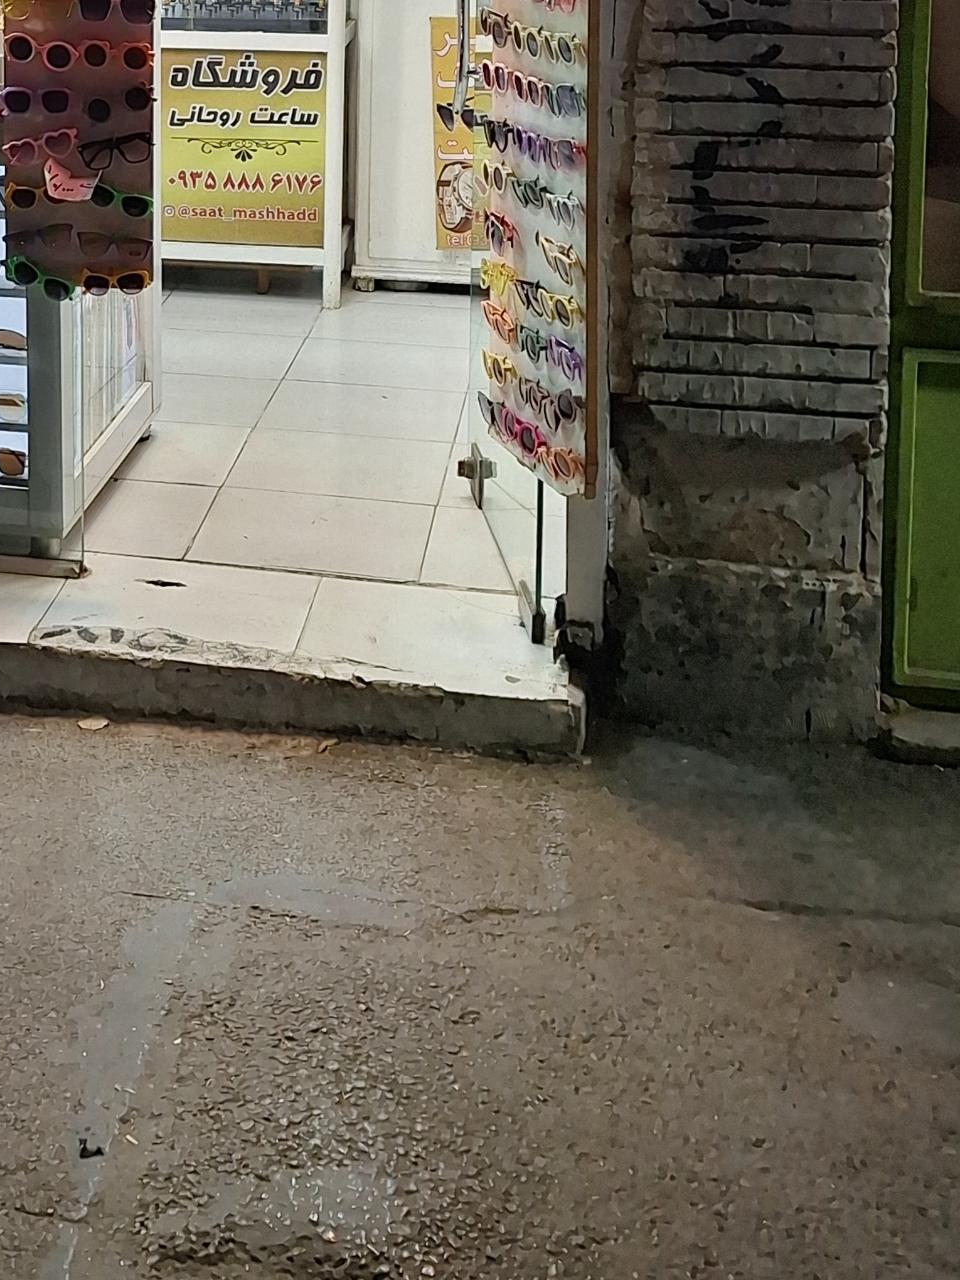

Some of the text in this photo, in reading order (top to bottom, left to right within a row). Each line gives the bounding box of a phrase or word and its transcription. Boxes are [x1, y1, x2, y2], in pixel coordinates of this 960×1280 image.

[169, 53, 324, 97] فروشگاه
[168, 104, 320, 129] ساعت روحانی
[168, 169, 323, 194] ۰۹۳۵ ۸۸۸ ۶۱۷۶
[177, 204, 319, 222] @saat_mashhadd
